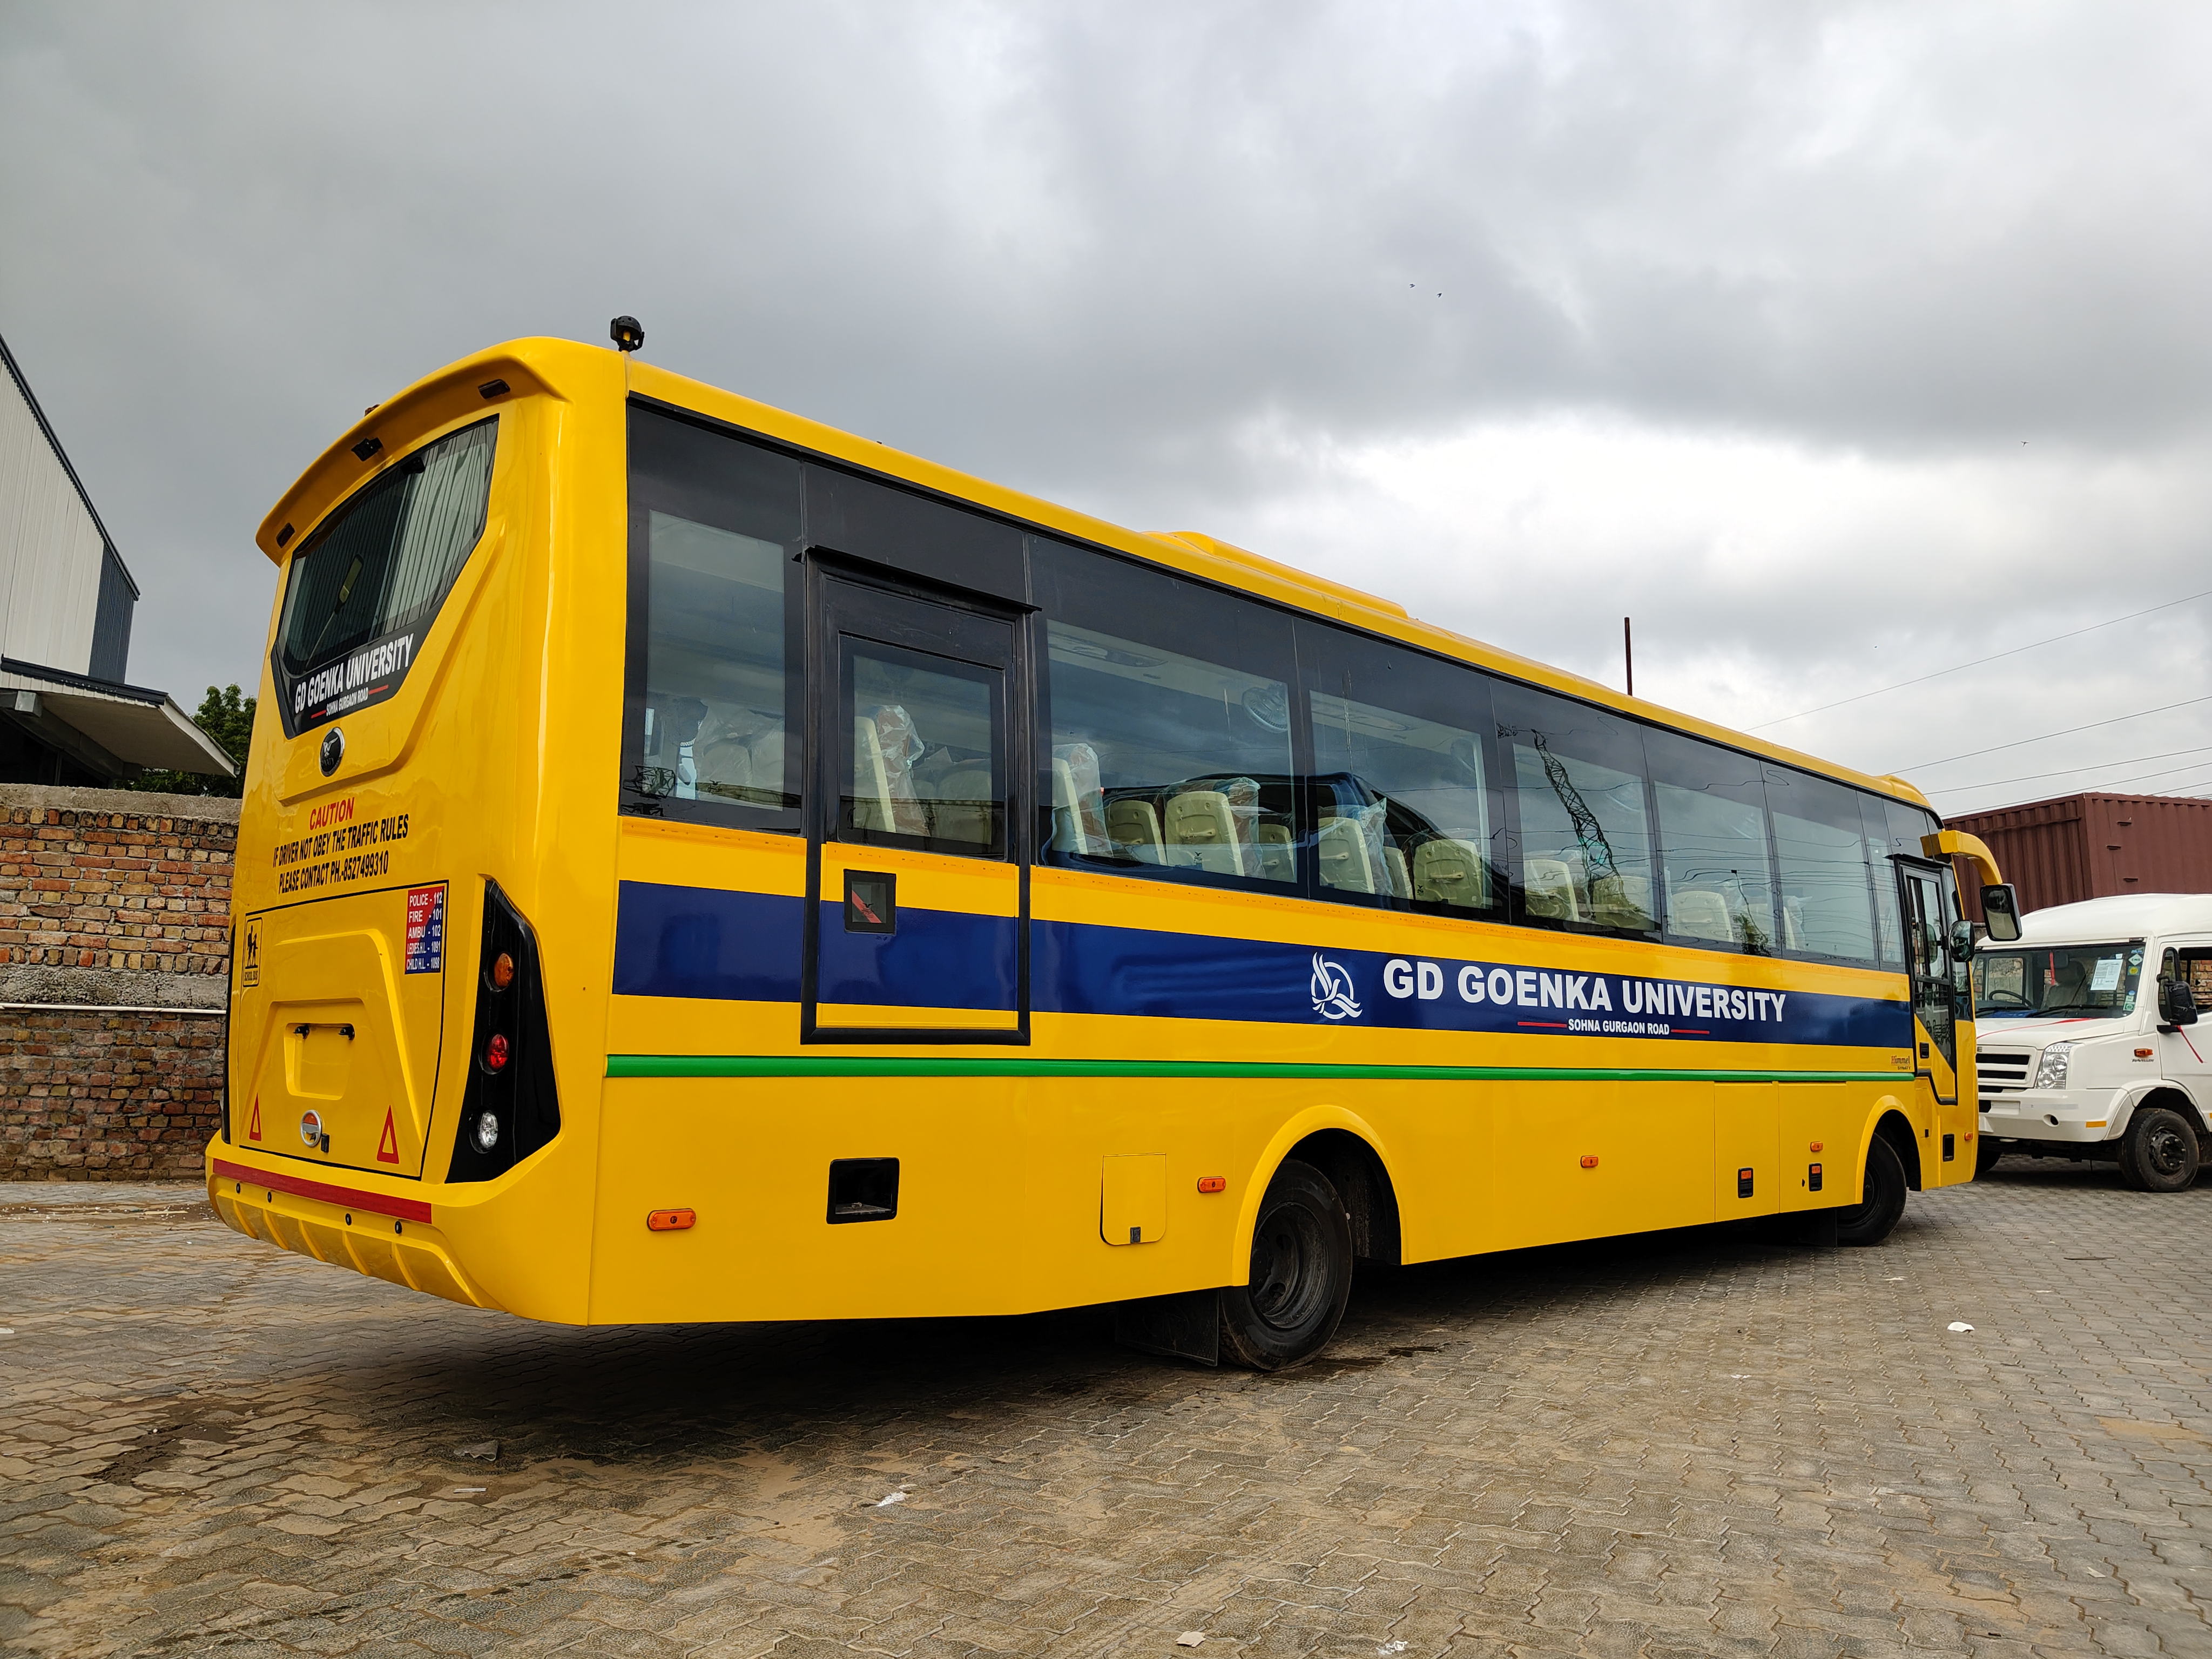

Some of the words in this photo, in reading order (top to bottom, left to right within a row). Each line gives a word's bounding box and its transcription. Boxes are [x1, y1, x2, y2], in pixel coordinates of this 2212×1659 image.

[295, 682, 306, 713] GD
[308, 662, 344, 707] GOENKA
[346, 633, 414, 690] UNIVERSITY
[326, 699, 338, 716] SOHNA
[339, 692, 358, 711] GURGAON
[358, 687, 368, 704] ROAD
[309, 797, 355, 831] CAUTION
[273, 847, 279, 868] IF
[279, 841, 299, 867] DRIVER
[299, 838, 313, 861] NOT
[313, 831, 331, 858] OBEY
[332, 828, 346, 853] THE
[347, 820, 379, 849] TRAFFIC
[380, 813, 409, 842] RULES
[278, 868, 299, 894] PLEASE
[300, 862, 330, 890] CONTACT
[409, 893, 428, 907] POLICE
[434, 891, 443, 904] 112
[408, 910, 423, 923] FIRE
[433, 908, 442, 920] 101
[408, 926, 426, 939] AMBU
[432, 925, 441, 936] 102
[431, 940, 440, 953] 1091
[407, 957, 417, 970] CHILD
[1383, 959, 1444, 1000] GD
[1458, 966, 1613, 1011] GOENKA
[1623, 980, 1786, 1022] UNIVERSITY
[1568, 1019, 1601, 1031] SOHNA
[1602, 1020, 1645, 1034] GURGAON
[1648, 1023, 1670, 1035] ROAD
[1891, 1055, 1910, 1064] Himmel
